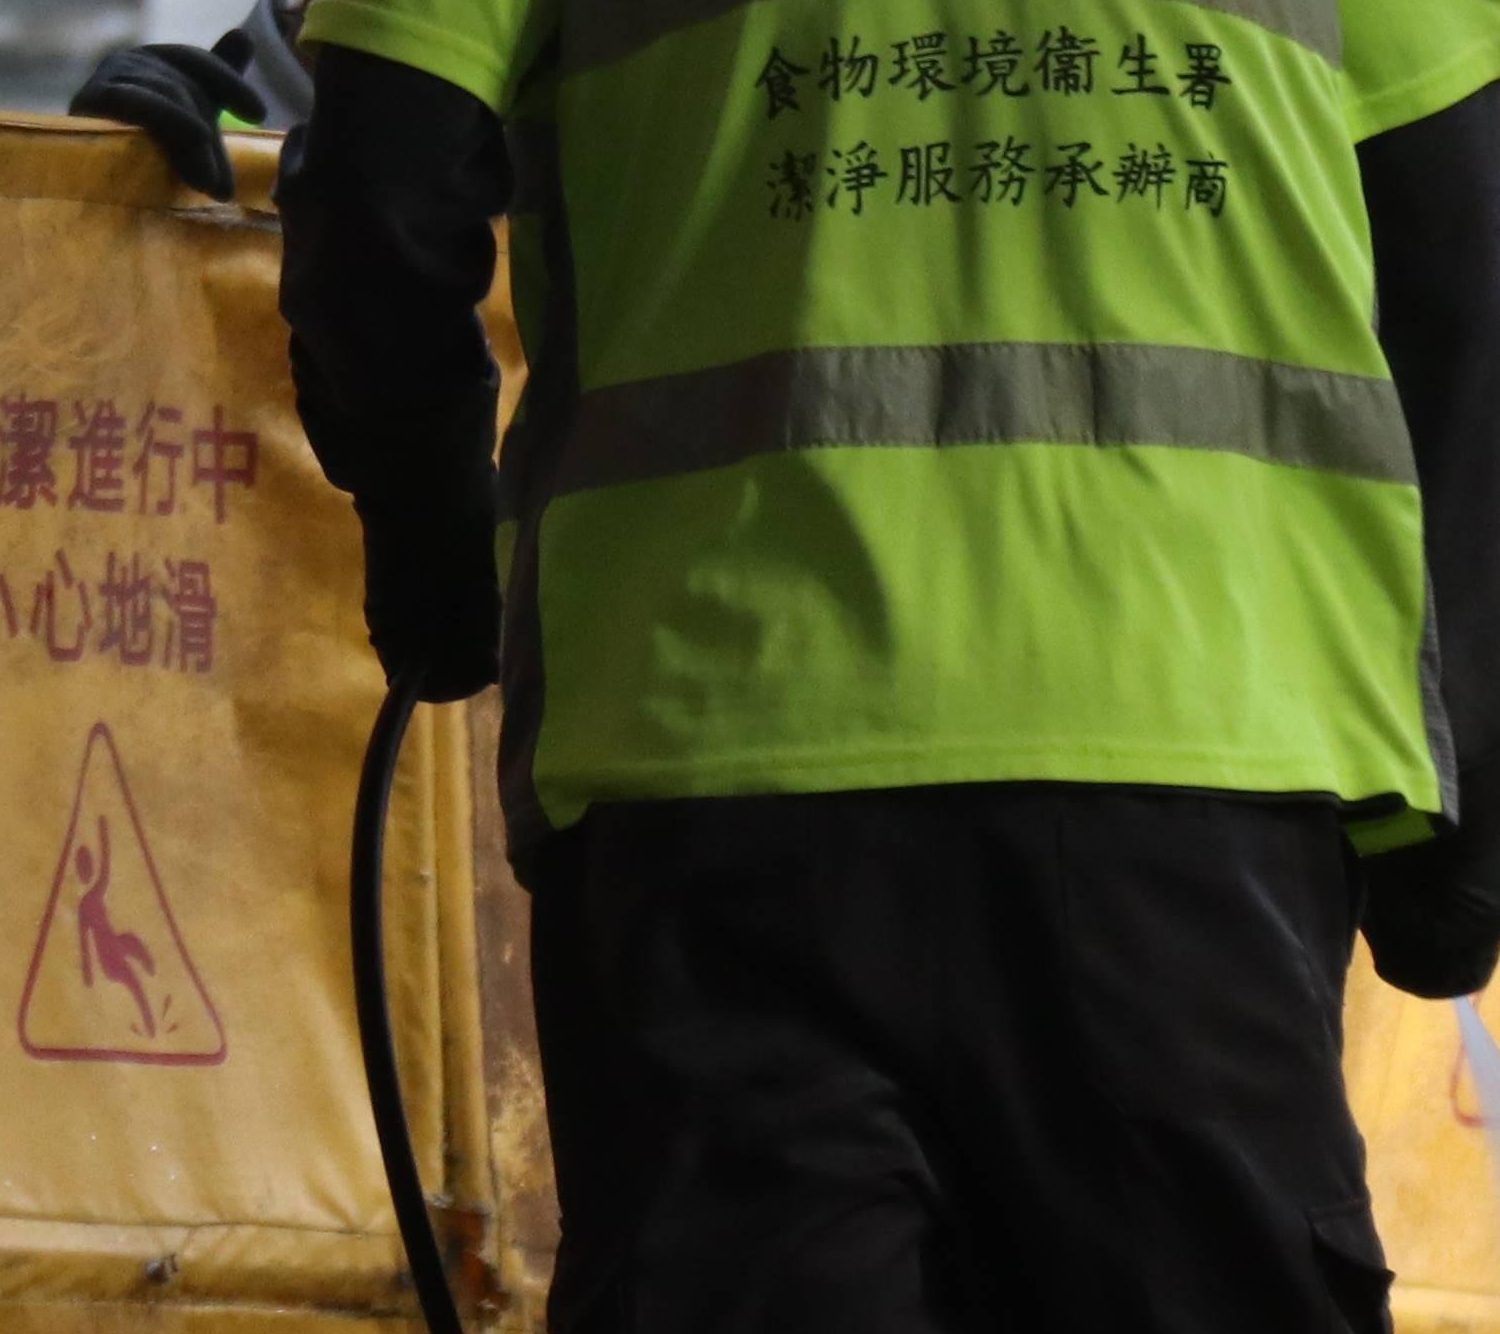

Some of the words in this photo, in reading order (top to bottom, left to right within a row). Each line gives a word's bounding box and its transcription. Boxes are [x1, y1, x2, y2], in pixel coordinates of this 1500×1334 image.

[766, 134, 1230, 220] 潔淨服務承辦商
